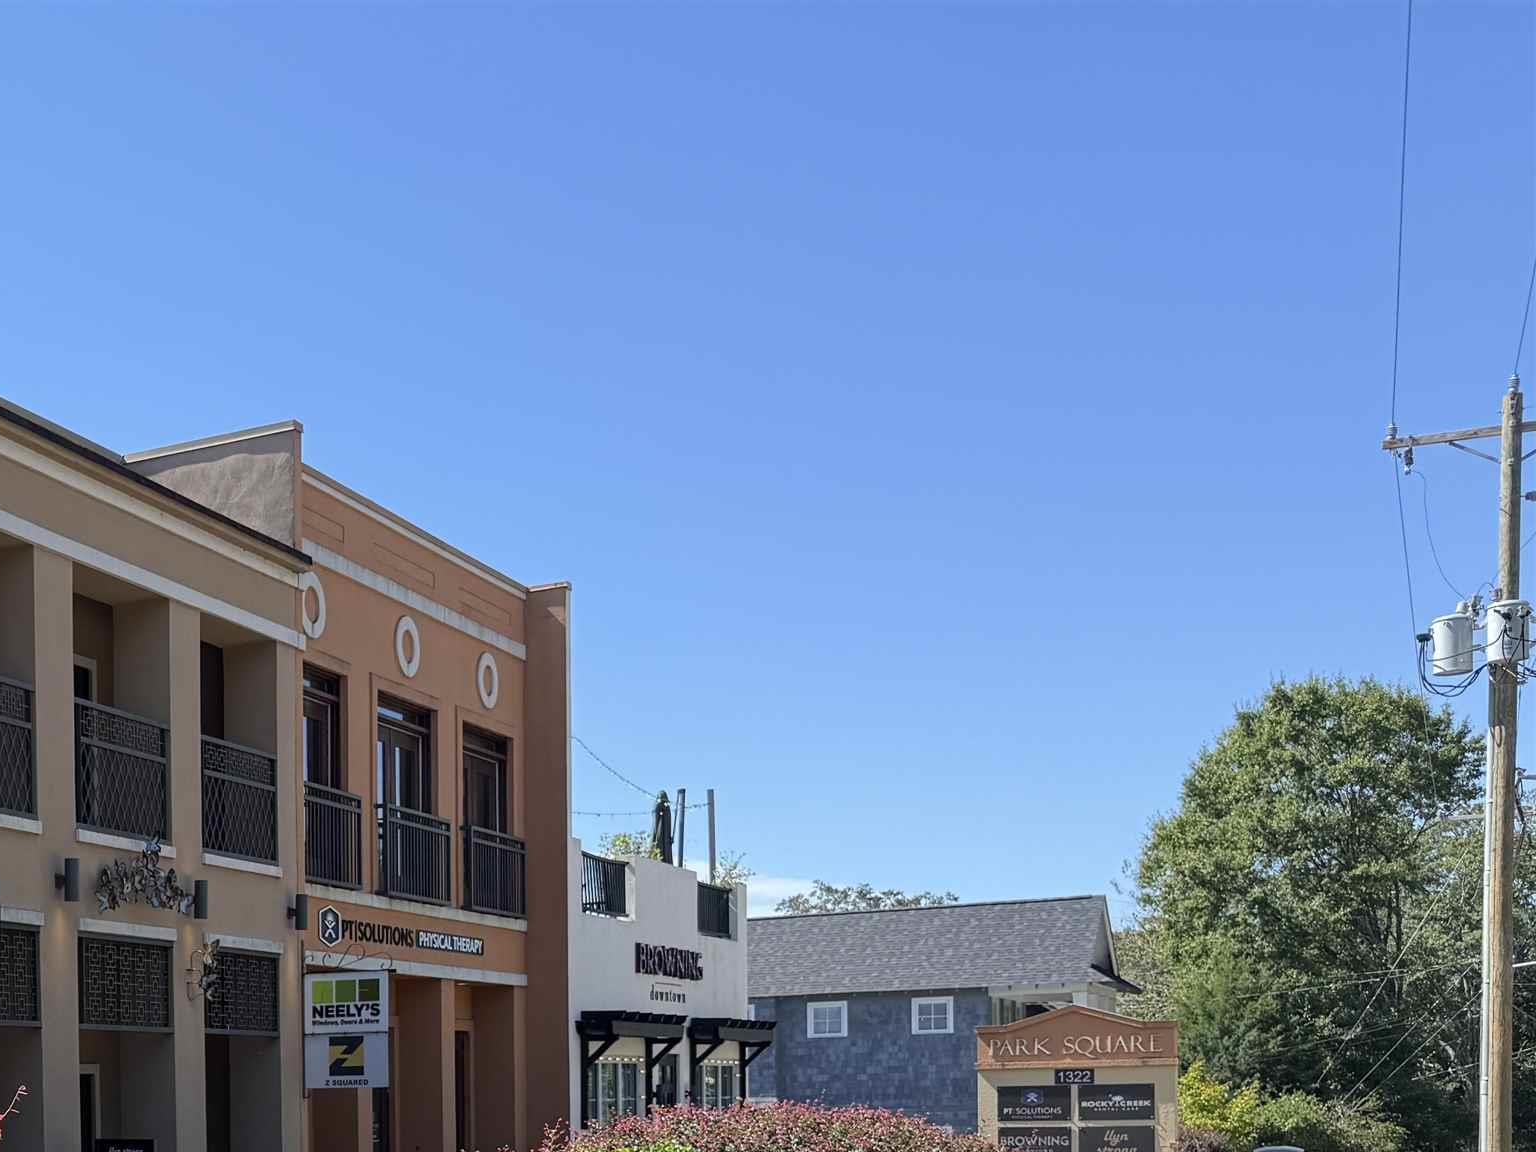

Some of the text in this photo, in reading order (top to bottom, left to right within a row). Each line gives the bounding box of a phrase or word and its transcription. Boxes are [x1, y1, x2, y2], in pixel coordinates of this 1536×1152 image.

[419, 932, 452, 950] PHYSICAL
[453, 936, 483, 954] THERAPY
[635, 942, 703, 981] BROWNING
[650, 984, 686, 1003] downtown
[312, 1003, 381, 1019] NEELY'S
[989, 1034, 1163, 1059] PARK SQUARE
[1057, 1070, 1092, 1083] 1322
[1080, 1099, 1151, 1108] ROCKY CREEK
[1000, 1135, 1070, 1146] BROWNING
[1104, 1130, 1129, 1145] llyn
